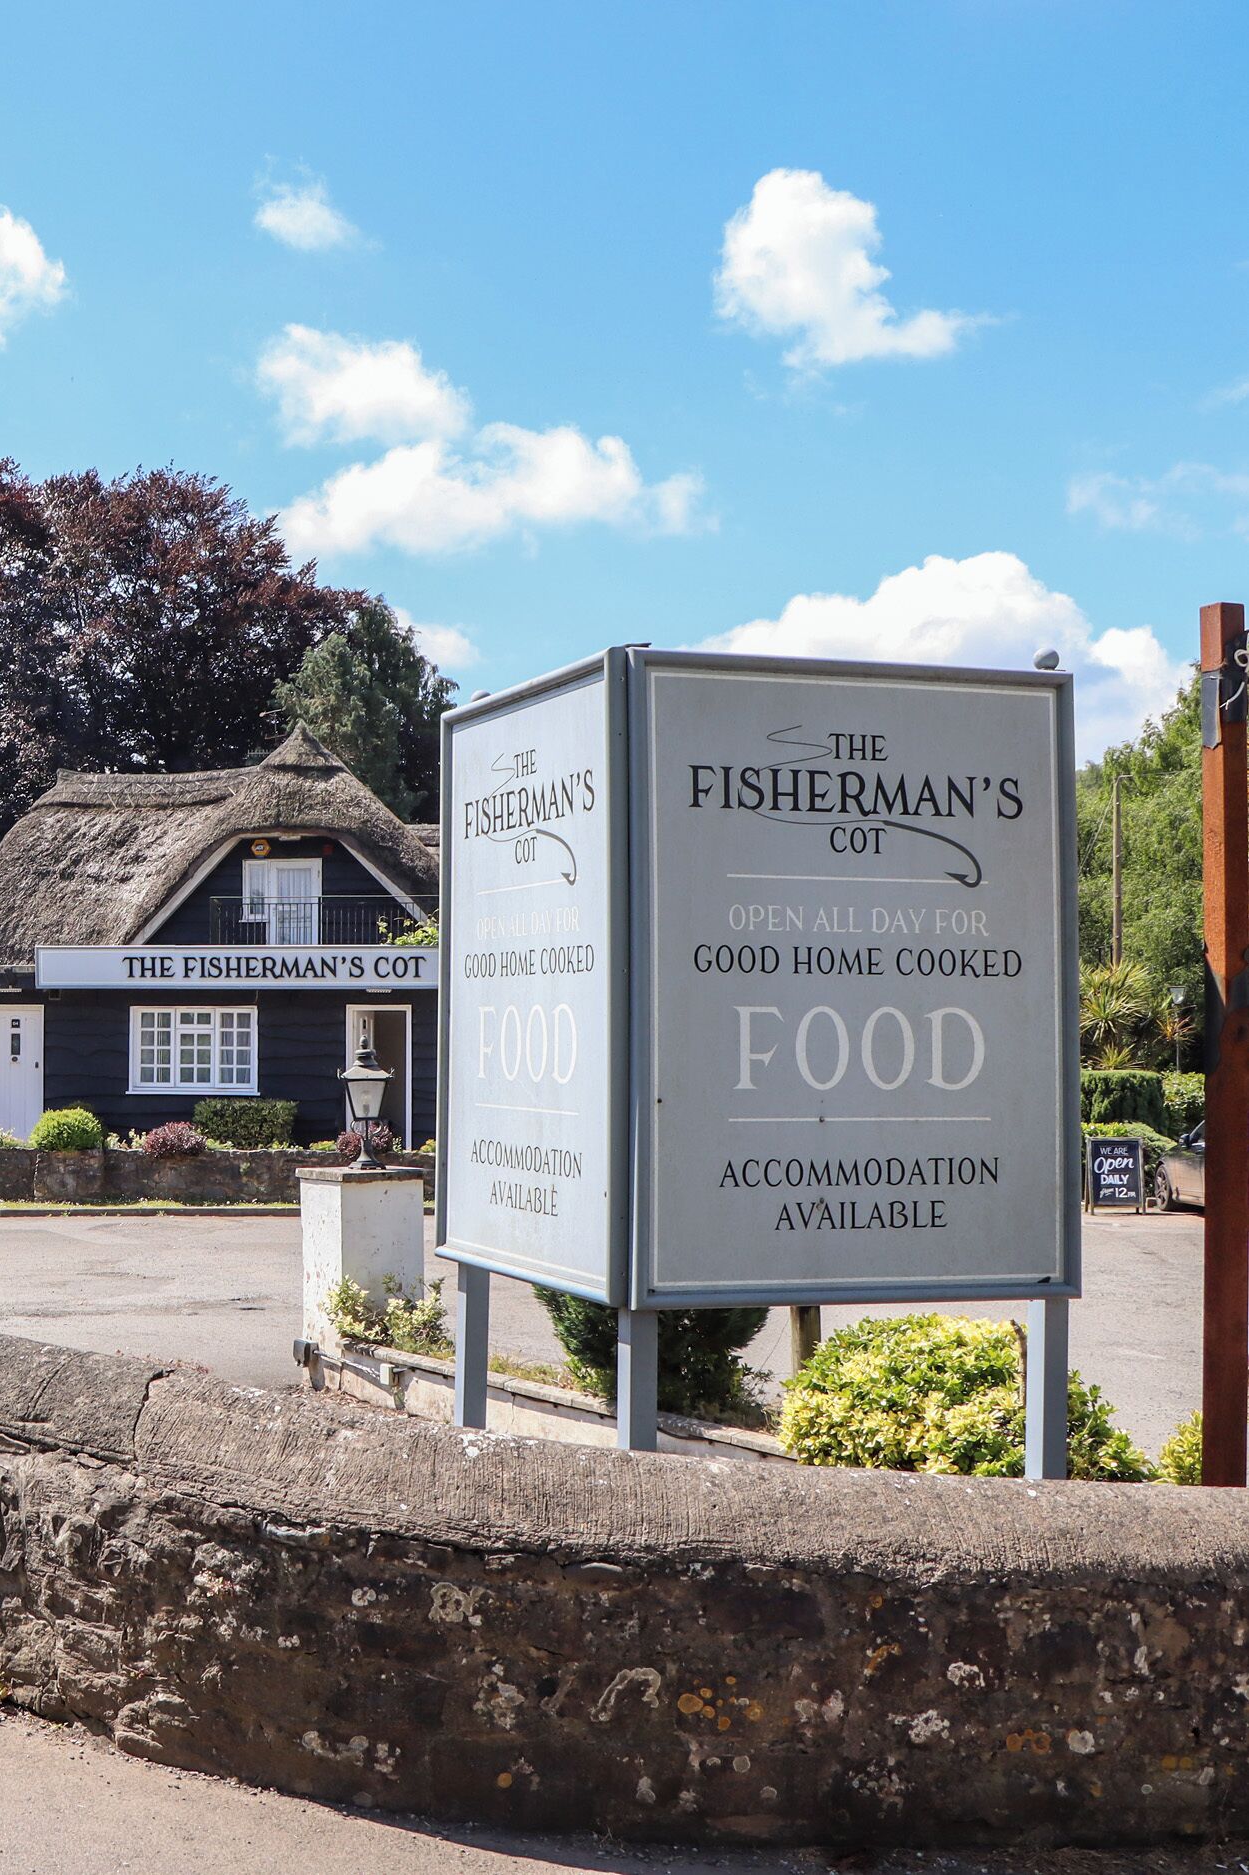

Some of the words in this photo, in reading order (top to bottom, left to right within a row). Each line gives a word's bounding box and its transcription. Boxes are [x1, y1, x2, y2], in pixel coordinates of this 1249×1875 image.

[513, 748, 537, 779] THE
[827, 732, 889, 762] THE
[464, 768, 595, 840] FISHERMAN'S
[688, 764, 1024, 820] FISHERMAN'S
[514, 836, 538, 865] COT
[829, 826, 888, 855] COT
[477, 912, 506, 941] OPEN
[508, 911, 528, 938] ALL
[531, 907, 552, 936] DAY
[555, 905, 580, 934] FOR
[728, 903, 804, 934] OPEN
[813, 906, 863, 934] ALL
[870, 907, 927, 935] DAY
[934, 908, 991, 937] FOR
[121, 955, 176, 979] THE
[182, 955, 366, 980] FISHERMAN'S
[374, 955, 427, 980] COT
[464, 952, 497, 979] GOOD
[499, 949, 536, 977] HOME
[540, 944, 595, 975] COOKED
[693, 944, 781, 975] GOOD
[792, 946, 886, 976] HOME
[895, 947, 1023, 979] COOKED
[477, 1003, 578, 1085] FOOD
[731, 1005, 986, 1091] FOOD
[470, 1138, 583, 1180] ACCOMMODATION
[1094, 1156, 1135, 1174] Open
[1100, 1147, 1112, 1155] WE
[1113, 1147, 1128, 1155] ARE
[718, 1156, 1000, 1189] ACCOMMODATION
[1100, 1174, 1129, 1185] DAILY
[489, 1180, 559, 1217] AVAILABLE
[774, 1200, 949, 1231] AVAILABLE
